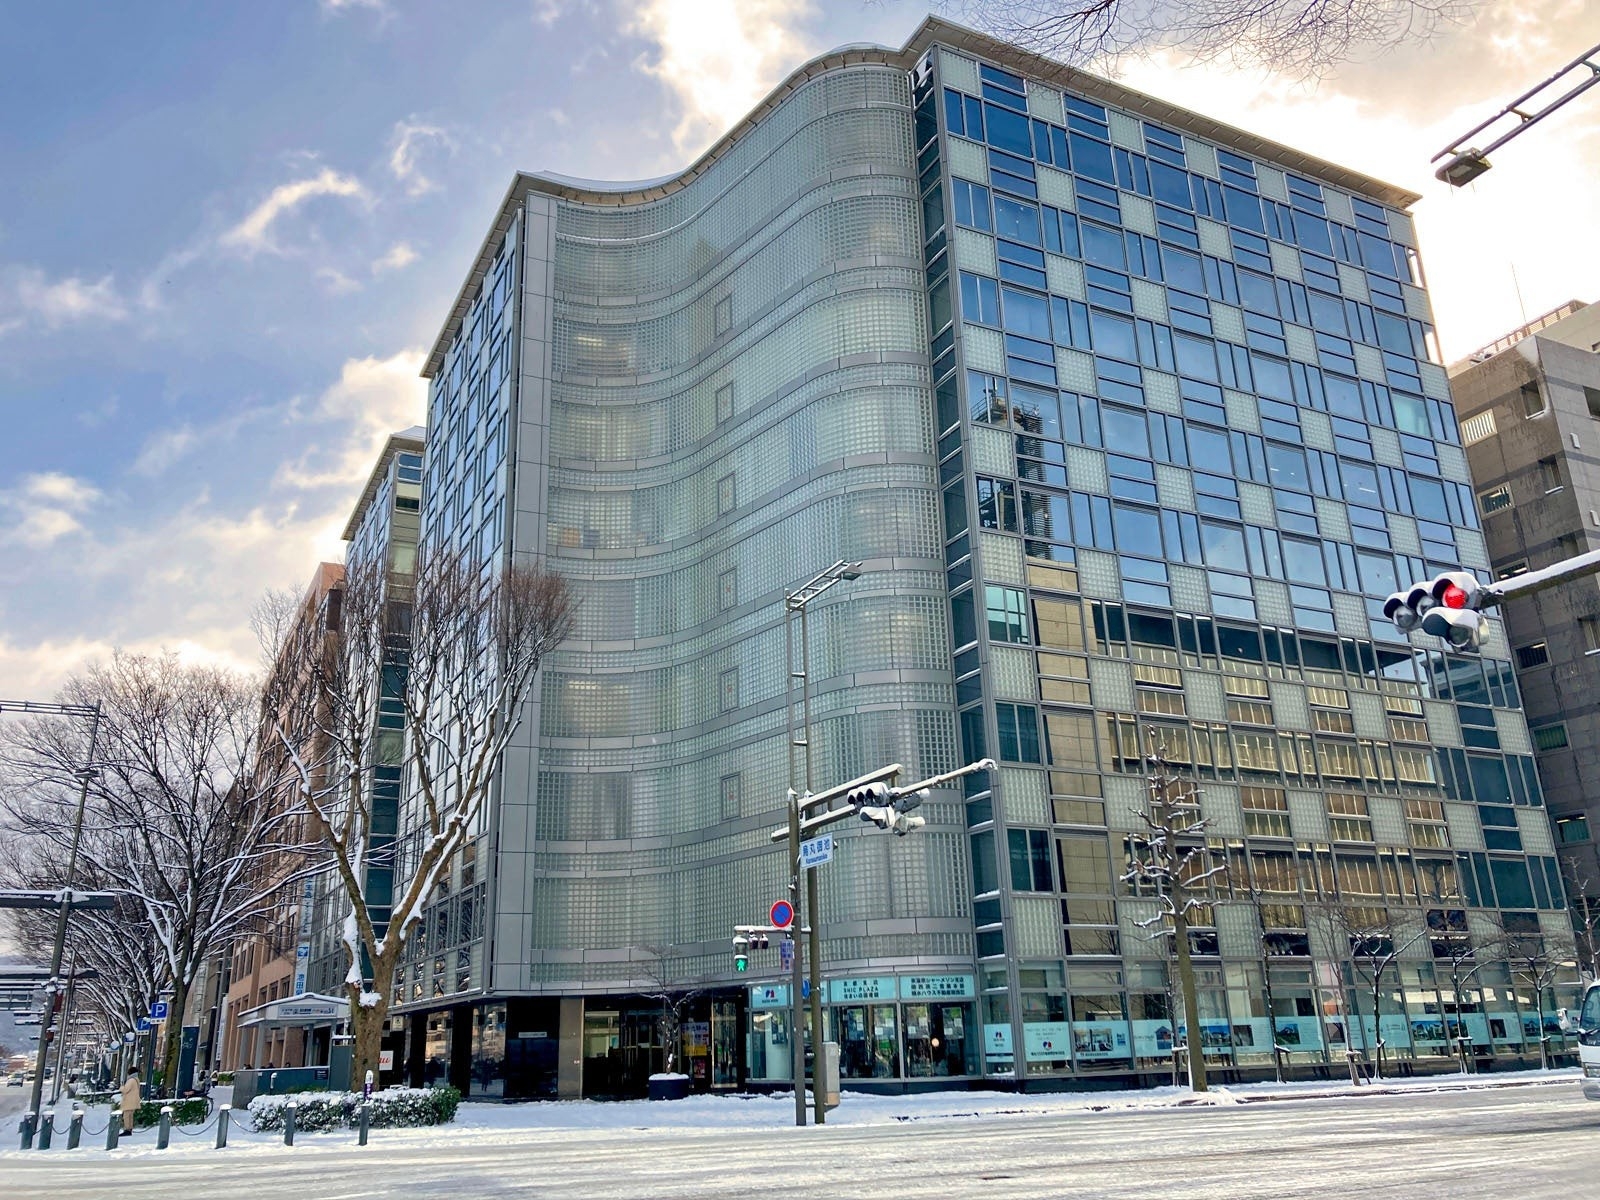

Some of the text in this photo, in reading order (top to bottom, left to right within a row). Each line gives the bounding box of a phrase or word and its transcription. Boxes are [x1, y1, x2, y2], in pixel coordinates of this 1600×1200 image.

[802, 838, 831, 857] 烏丸御池
[155, 1004, 165, 1017] P
